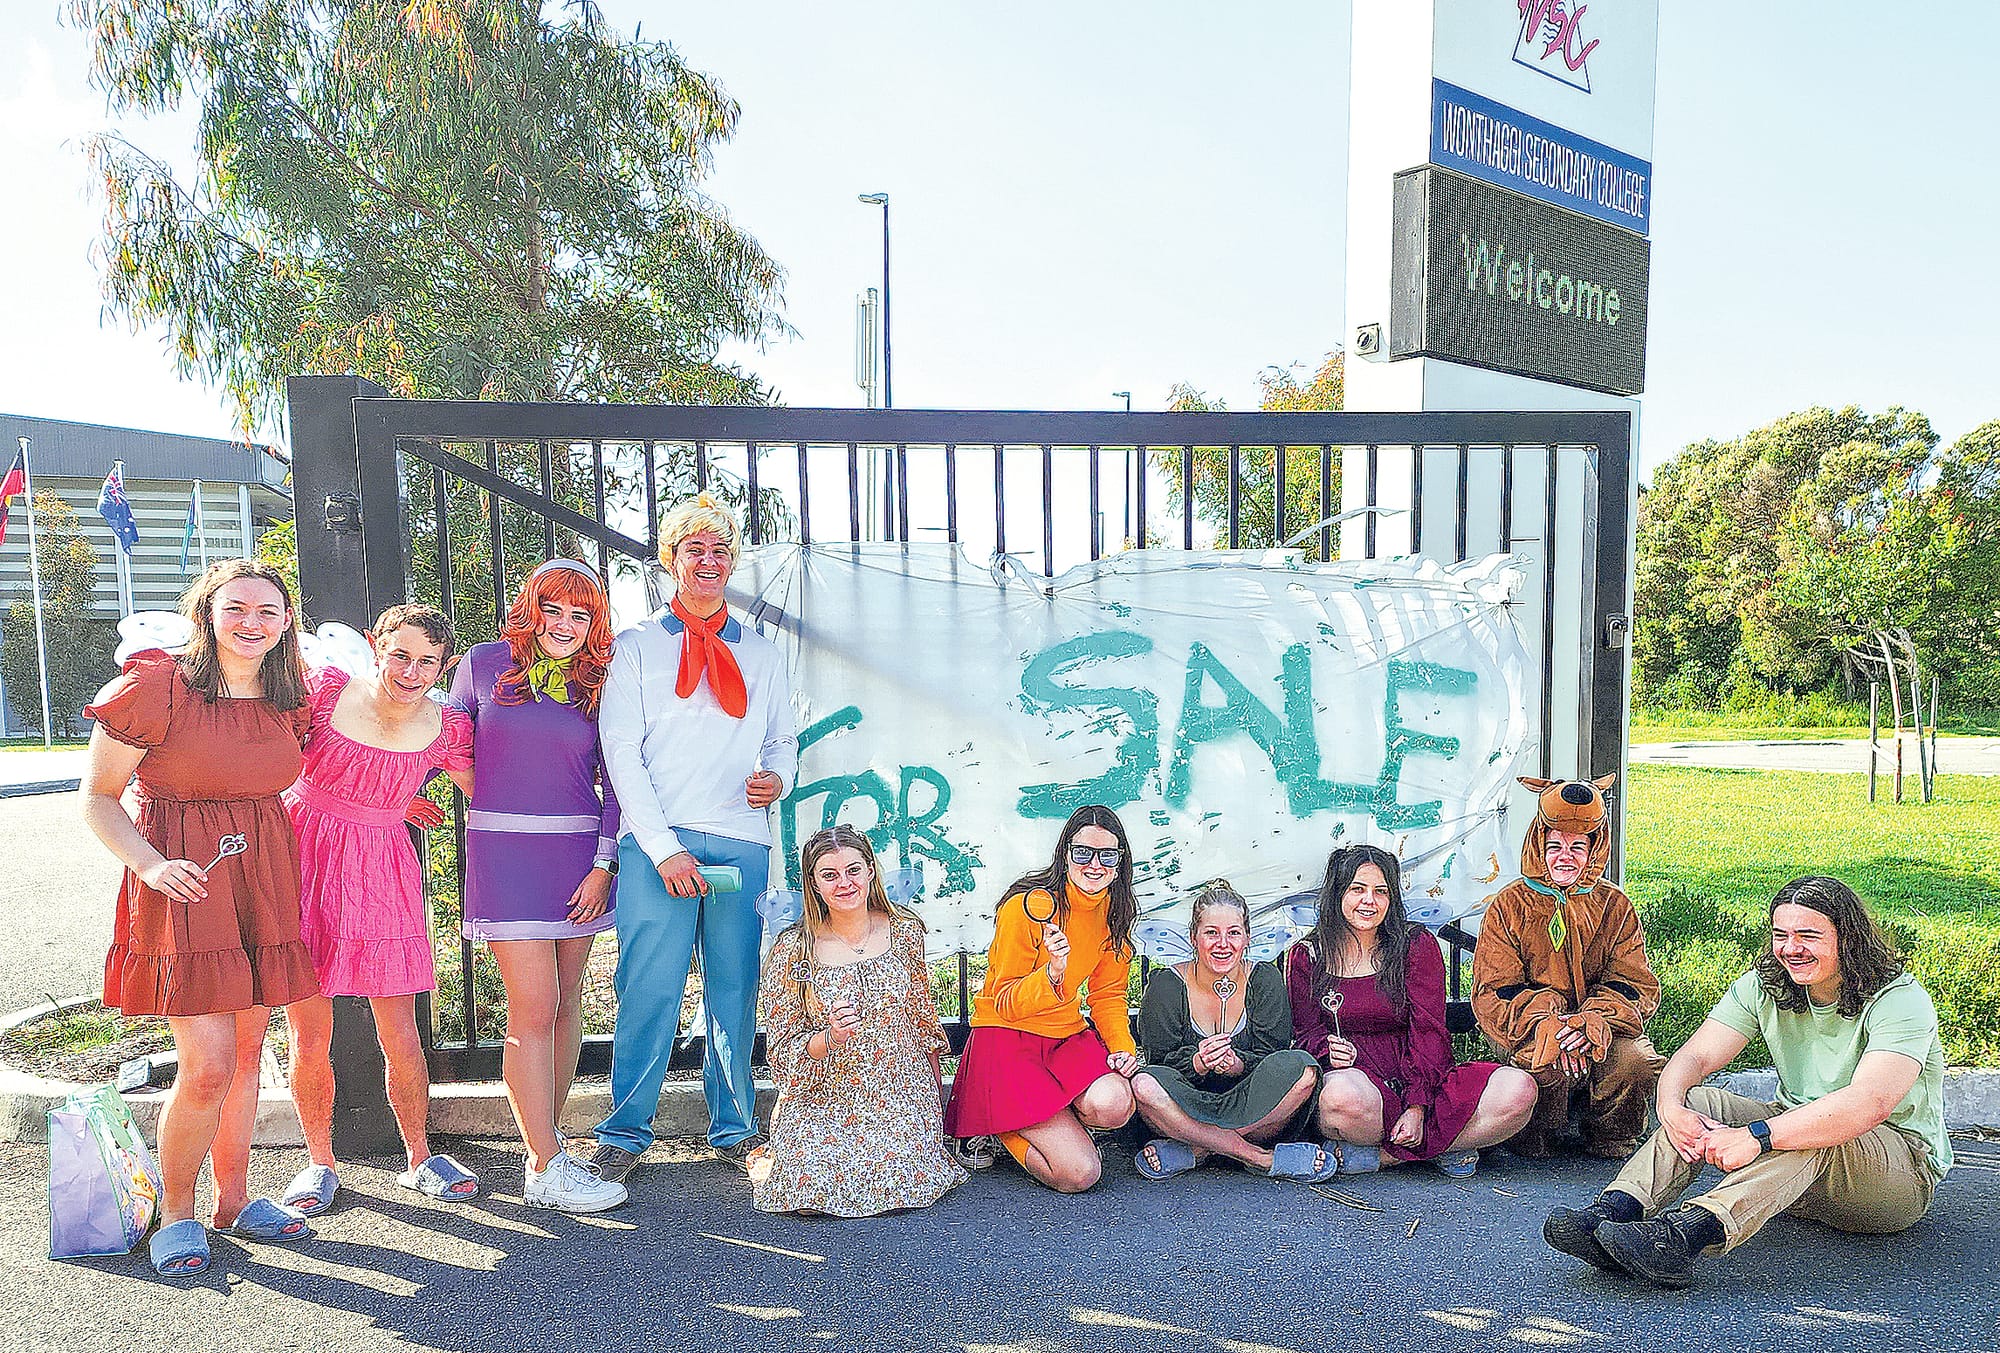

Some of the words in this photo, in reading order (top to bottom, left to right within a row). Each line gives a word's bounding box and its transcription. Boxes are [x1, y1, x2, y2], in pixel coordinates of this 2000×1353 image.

[1442, 100, 1523, 177] WONTHAGGI
[1524, 134, 1597, 201] SECONDARY
[1597, 160, 1646, 219] COLLEGE
[1459, 232, 1622, 325] Welcome
[780, 705, 976, 894] FOR
[1017, 630, 1478, 830] SALE
